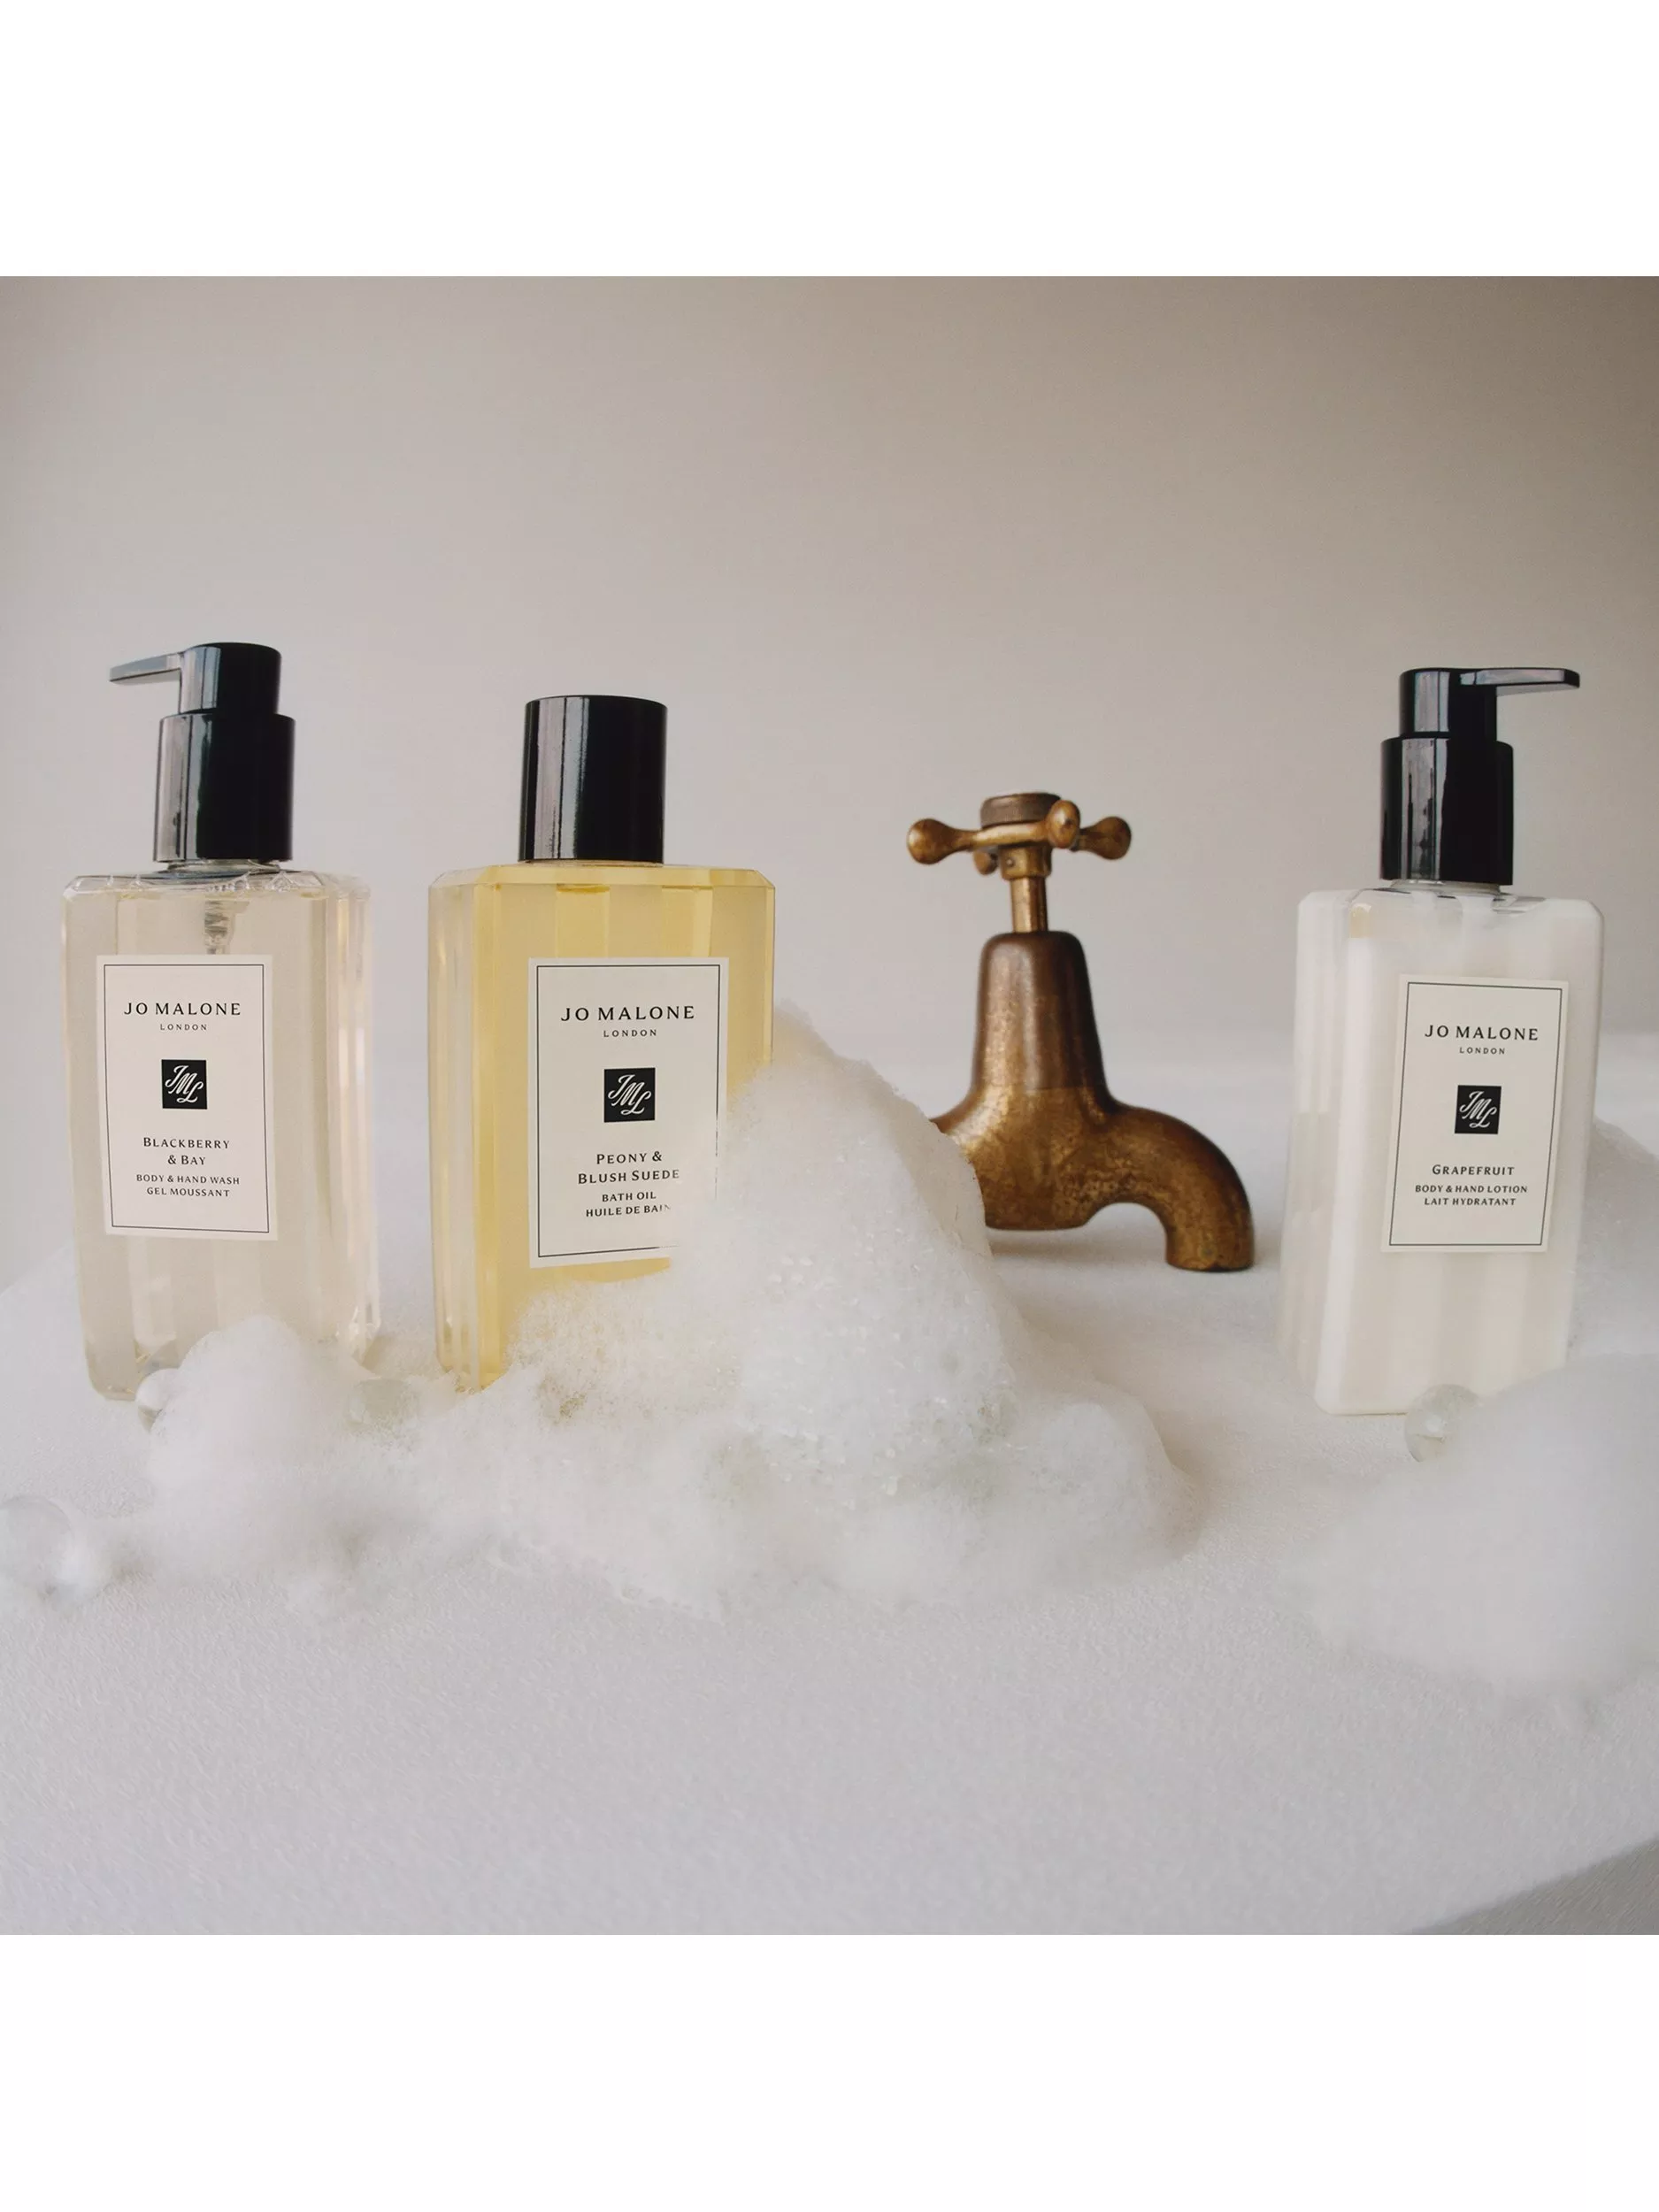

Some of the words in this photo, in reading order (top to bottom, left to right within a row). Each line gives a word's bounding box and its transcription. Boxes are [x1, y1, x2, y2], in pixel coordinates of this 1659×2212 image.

[123, 1002, 149, 1016] JO
[155, 1002, 241, 1016] MALONE
[560, 1007, 589, 1022] JO
[597, 1005, 695, 1021] MALONE
[603, 1028, 657, 1038] LONDON
[1425, 1025, 1449, 1038] JO
[1455, 1025, 1539, 1041] MALONE
[1459, 1046, 1505, 1055] LONDON
[143, 1137, 230, 1149] BLACKBERRY
[167, 1154, 177, 1165] &
[180, 1155, 206, 1166] BAY
[596, 1152, 648, 1165] PEONY
[651, 1150, 662, 1163] &
[1432, 1164, 1515, 1176] GRAPEFRUIT
[135, 1173, 165, 1183] BODY
[166, 1174, 174, 1183] &
[177, 1175, 207, 1184] HAND
[210, 1176, 240, 1186] WASH
[578, 1171, 626, 1185] BLUSH
[631, 1169, 680, 1181] SUEDE
[146, 1187, 167, 1195] GEL
[170, 1187, 230, 1197] MOUSSANT
[1415, 1184, 1444, 1194] BODY
[1445, 1185, 1453, 1194] &
[1455, 1185, 1485, 1194] HAND
[1486, 1185, 1528, 1194] LOTION
[602, 1192, 634, 1202] BATH
[636, 1191, 657, 1201] OIL
[1424, 1197, 1449, 1206] LAIT
[1452, 1197, 1517, 1206] HYDRATANT
[586, 1207, 623, 1217] HUILE
[625, 1205, 641, 1215] DE
